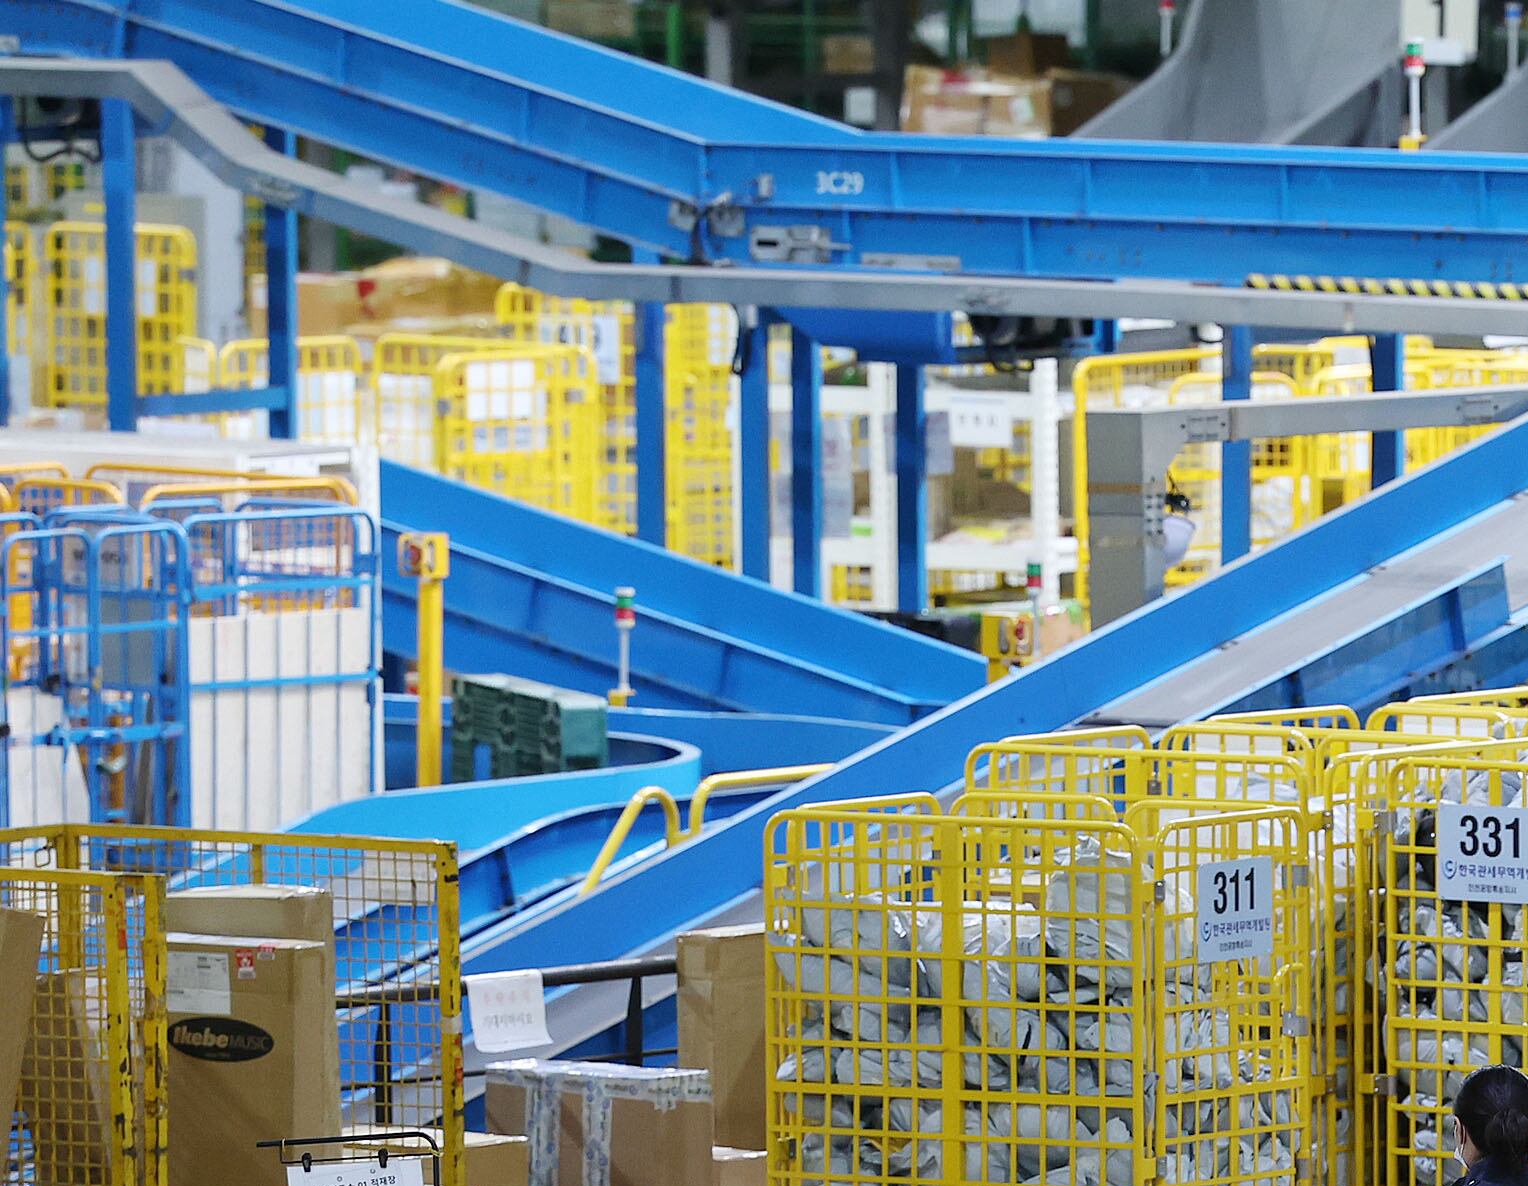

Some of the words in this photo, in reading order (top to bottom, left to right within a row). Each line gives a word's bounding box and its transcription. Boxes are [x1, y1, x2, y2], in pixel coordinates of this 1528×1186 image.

[815, 170, 864, 195] 3C29
[1460, 815, 1520, 858] 331
[1213, 867, 1254, 914] 311
